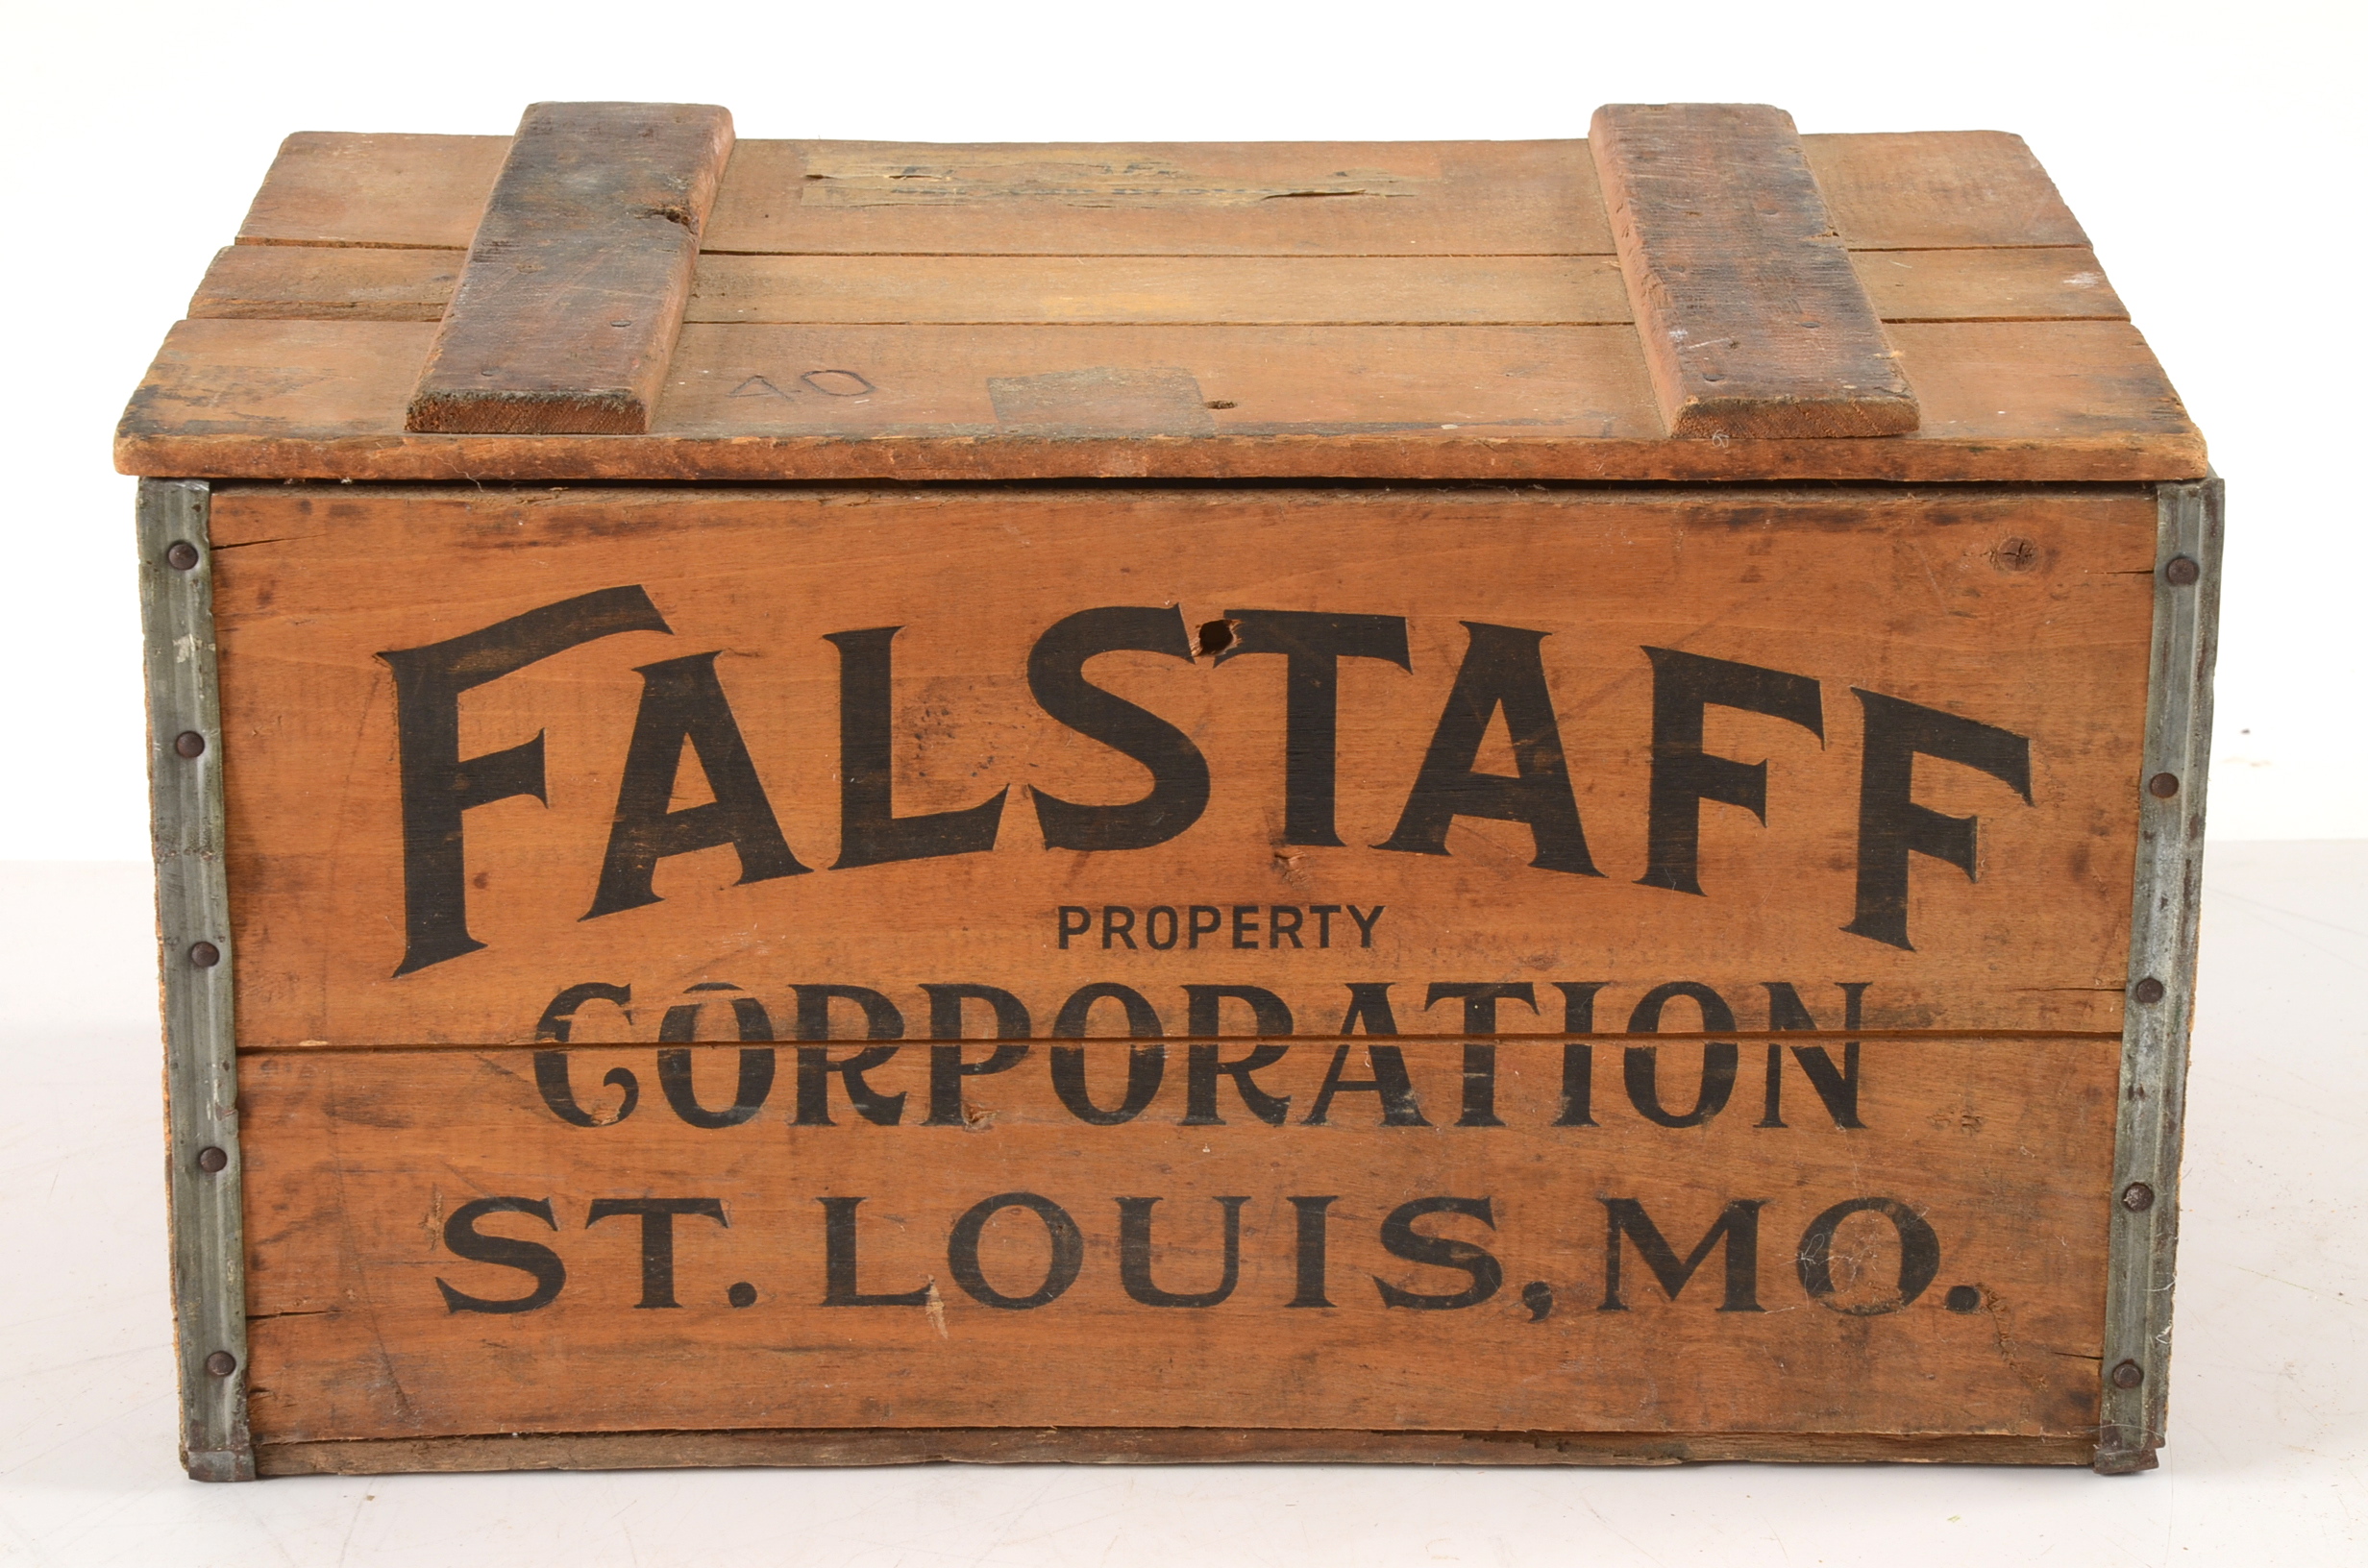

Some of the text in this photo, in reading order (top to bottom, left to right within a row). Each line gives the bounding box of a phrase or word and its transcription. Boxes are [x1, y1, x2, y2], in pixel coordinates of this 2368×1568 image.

[375, 584, 2034, 978] FALSTAFF
[1058, 904, 1385, 950] PROPERTY
[534, 981, 1872, 1129] CORPORATION
[435, 1192, 1981, 1323] ST. LOUIS, MO.
